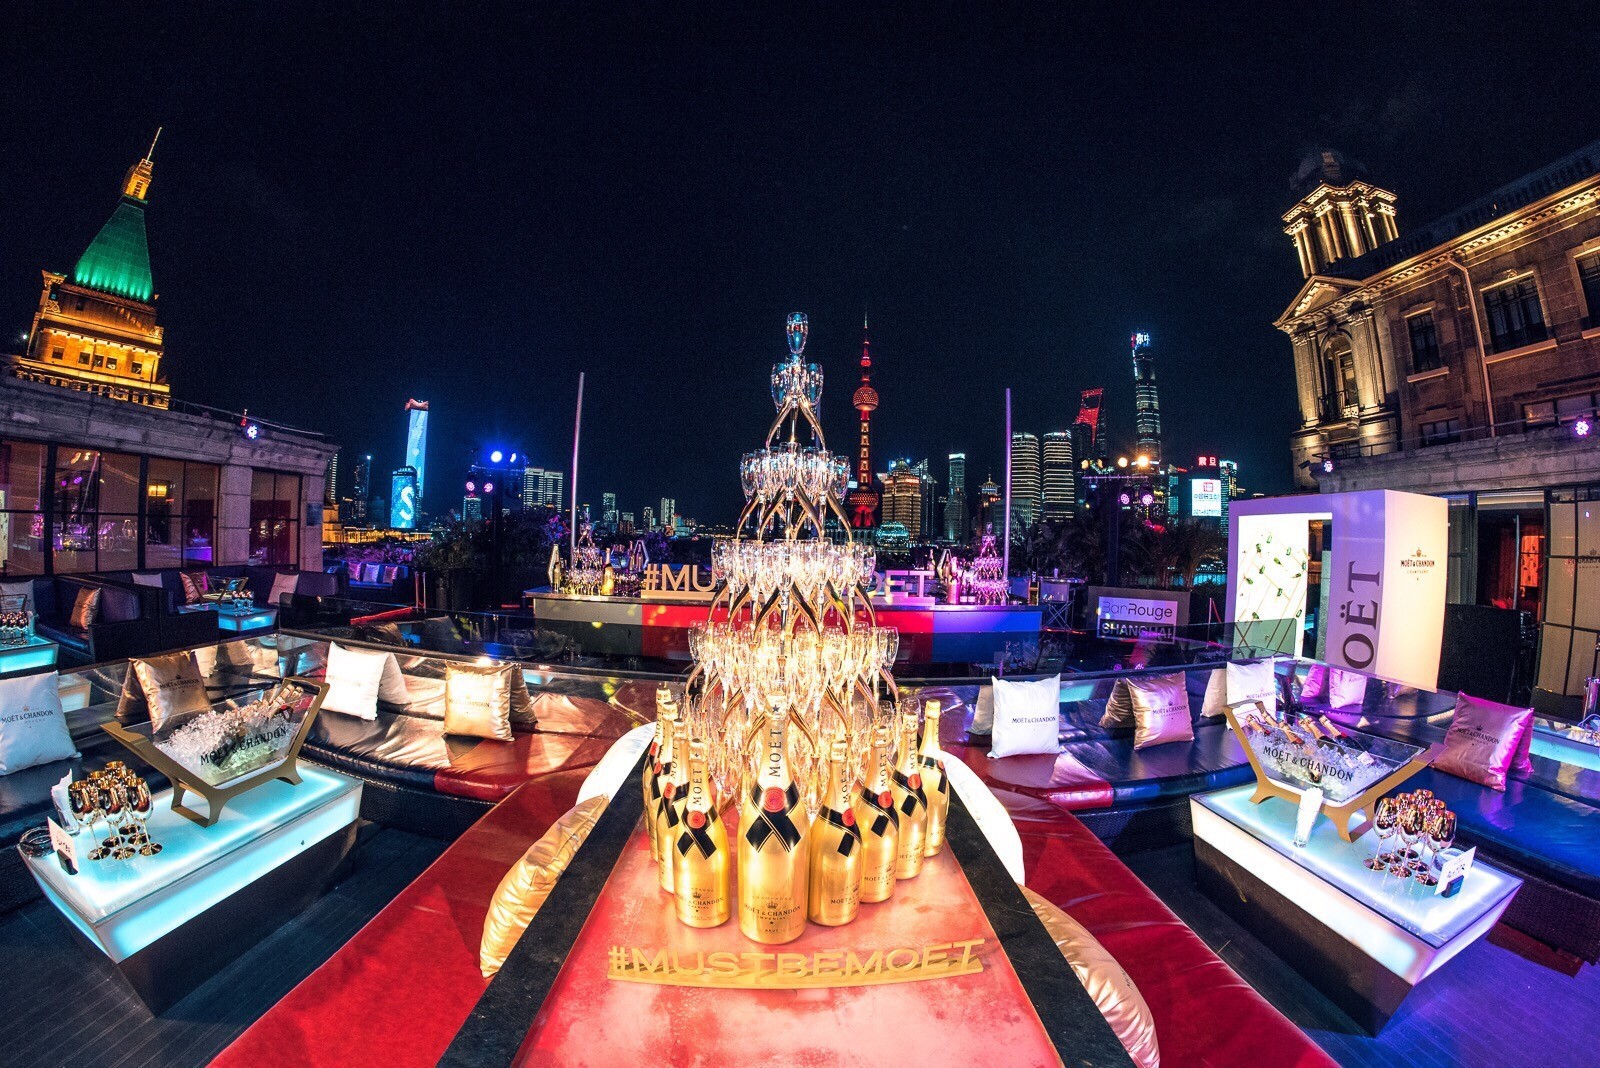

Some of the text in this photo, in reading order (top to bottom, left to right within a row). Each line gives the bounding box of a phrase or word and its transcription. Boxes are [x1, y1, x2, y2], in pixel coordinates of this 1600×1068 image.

[1340, 561, 1380, 669] OËT
[24, 710, 54, 719] CHANDON
[1473, 731, 1500, 744] CHANDON
[1300, 757, 1354, 781] CHANDON
[767, 905, 801, 917] CHANDON
[608, 938, 985, 984] #MUSTBEMOET
